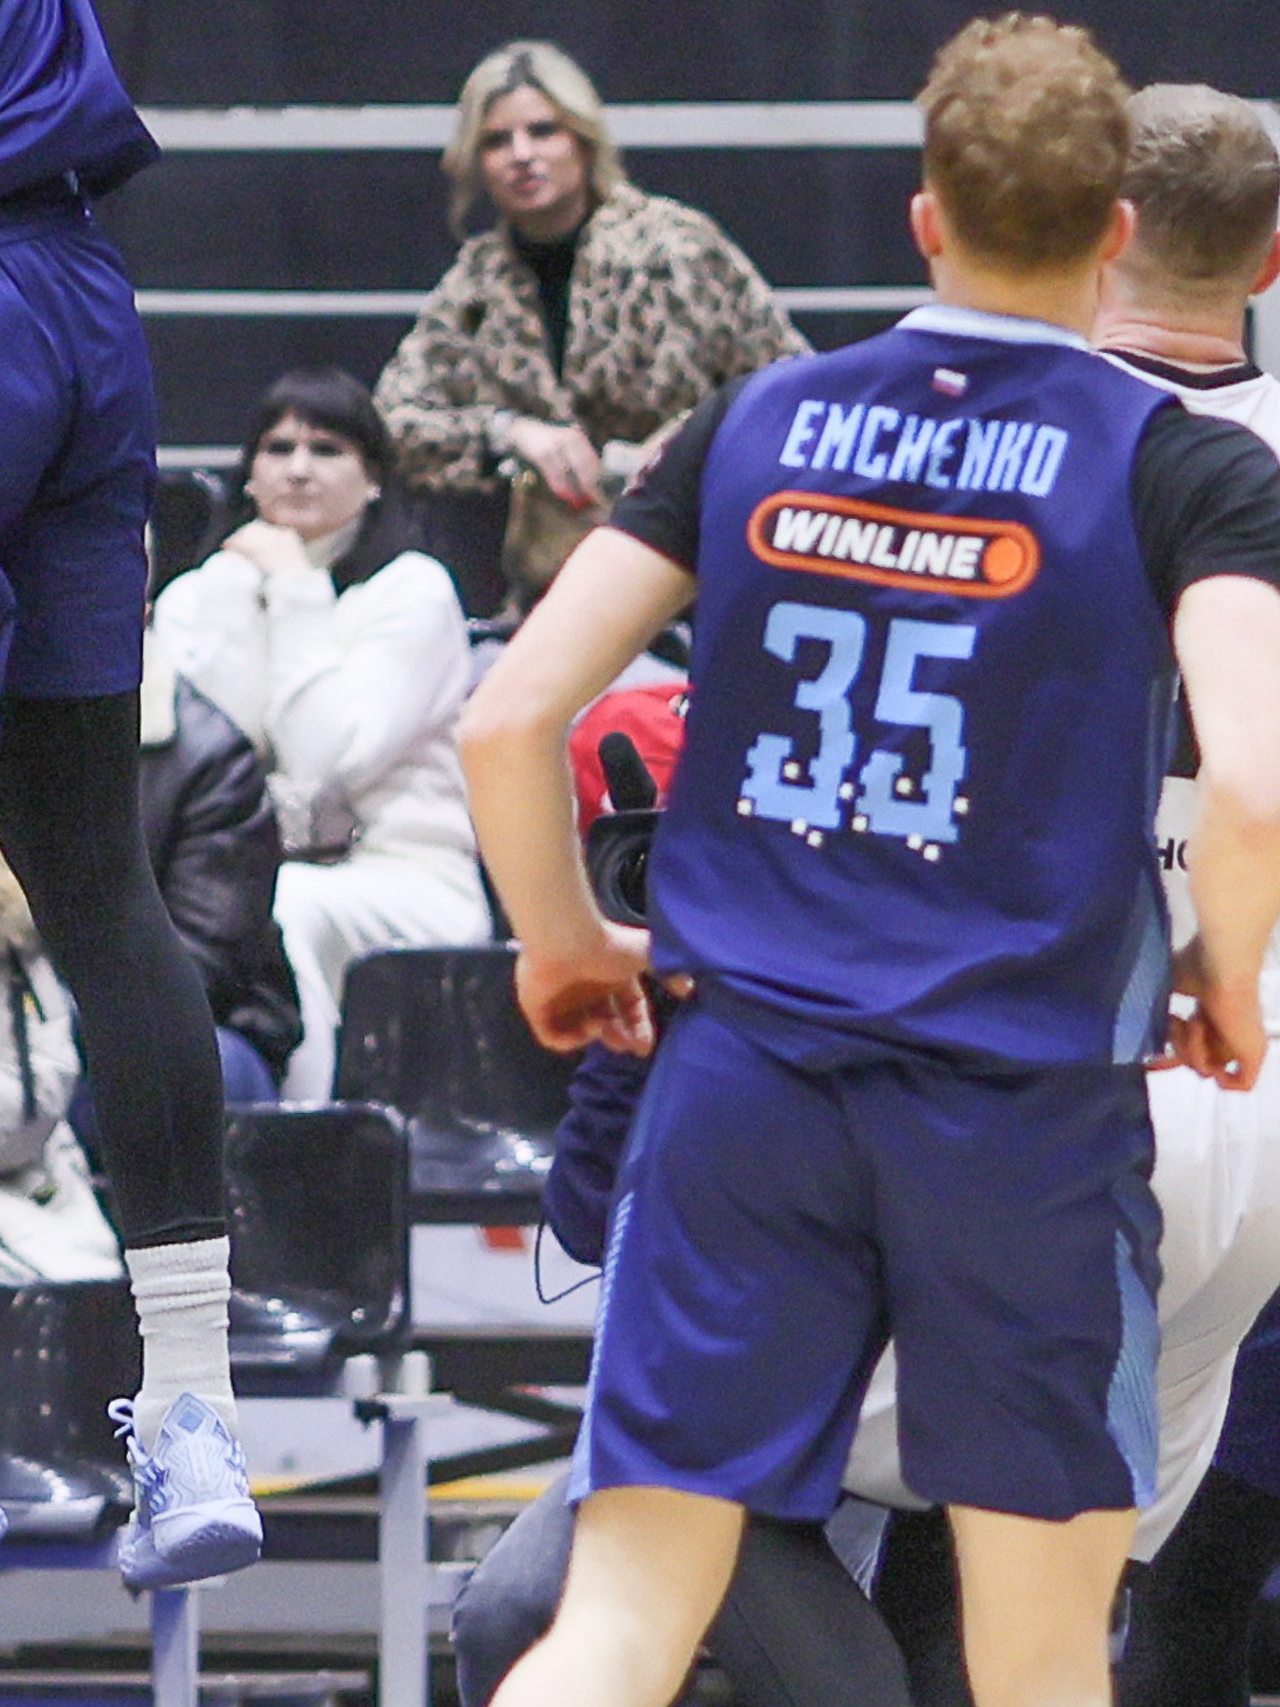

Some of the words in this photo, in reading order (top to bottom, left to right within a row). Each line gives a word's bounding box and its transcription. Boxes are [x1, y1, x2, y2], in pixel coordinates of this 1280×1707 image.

[778, 399, 1069, 498] EMCHENKO
[771, 506, 984, 580] WINLINE
[740, 600, 980, 854] 35
